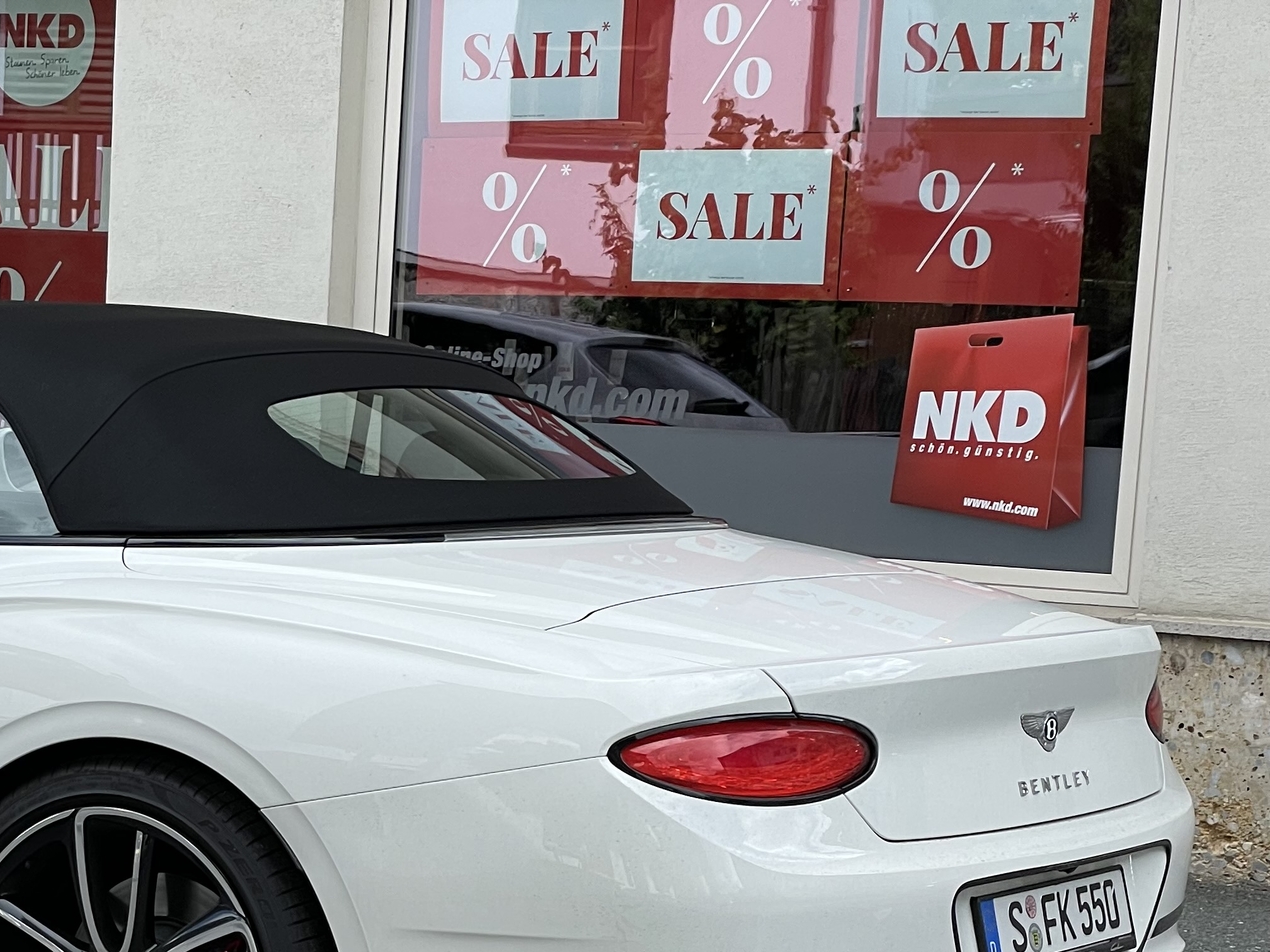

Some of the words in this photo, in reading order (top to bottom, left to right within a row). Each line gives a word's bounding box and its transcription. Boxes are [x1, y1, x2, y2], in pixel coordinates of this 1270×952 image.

[424, 345, 543, 374] line-Shop
[525, 376, 690, 421] nkd.com
[912, 390, 1047, 443] NKD
[910, 443, 1039, 462] schön.günstig.
[962, 496, 1039, 517] www.nkd.com
[1017, 769, 1091, 797] BENTLEY
[1008, 900, 1028, 952] S
[1041, 888, 1077, 945] FK
[1076, 879, 1121, 935] 550
